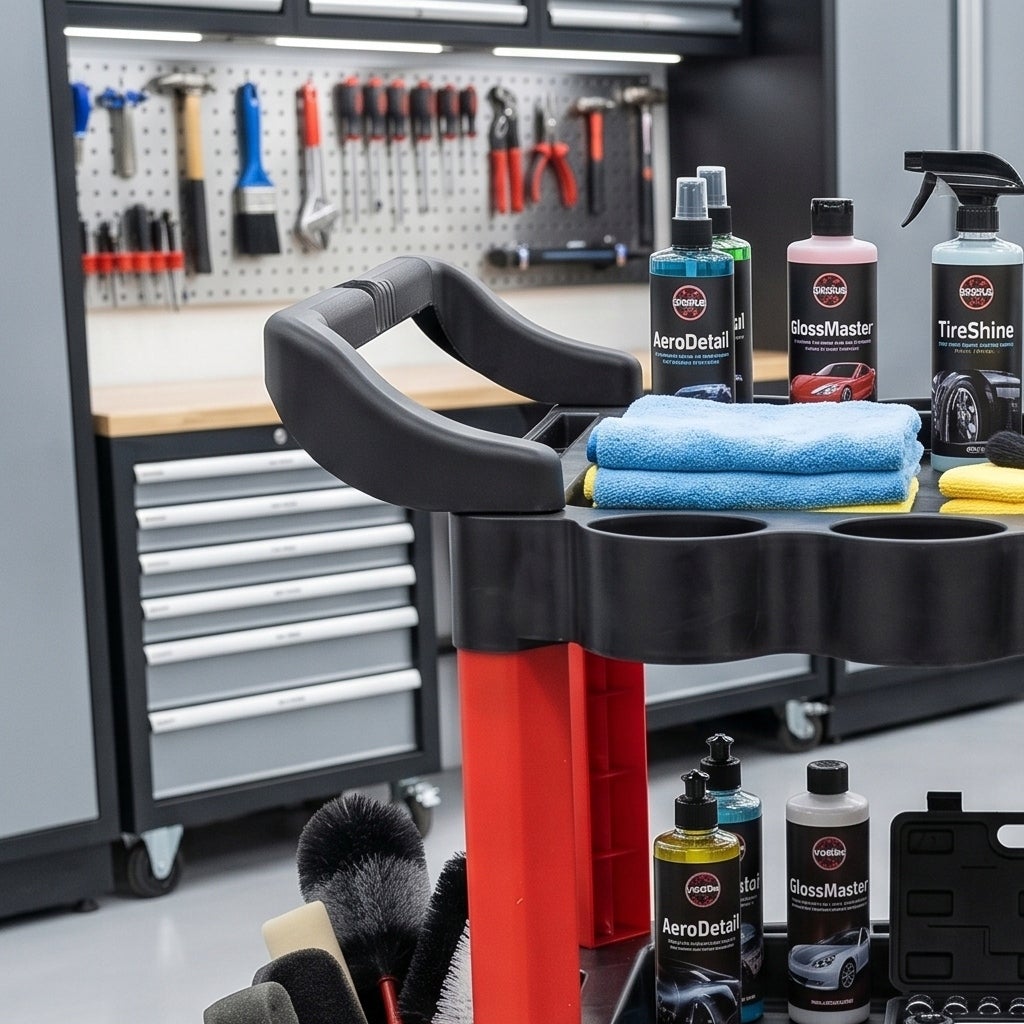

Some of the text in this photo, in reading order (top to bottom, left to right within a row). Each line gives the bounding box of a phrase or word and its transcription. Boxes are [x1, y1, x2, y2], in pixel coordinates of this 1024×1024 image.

[791, 319, 874, 337] GlossMaster
[938, 320, 1014, 340] TireShine
[653, 330, 730, 351] AeroDetail
[790, 877, 870, 899] GlossMaster
[662, 912, 740, 938] AeroDetail
